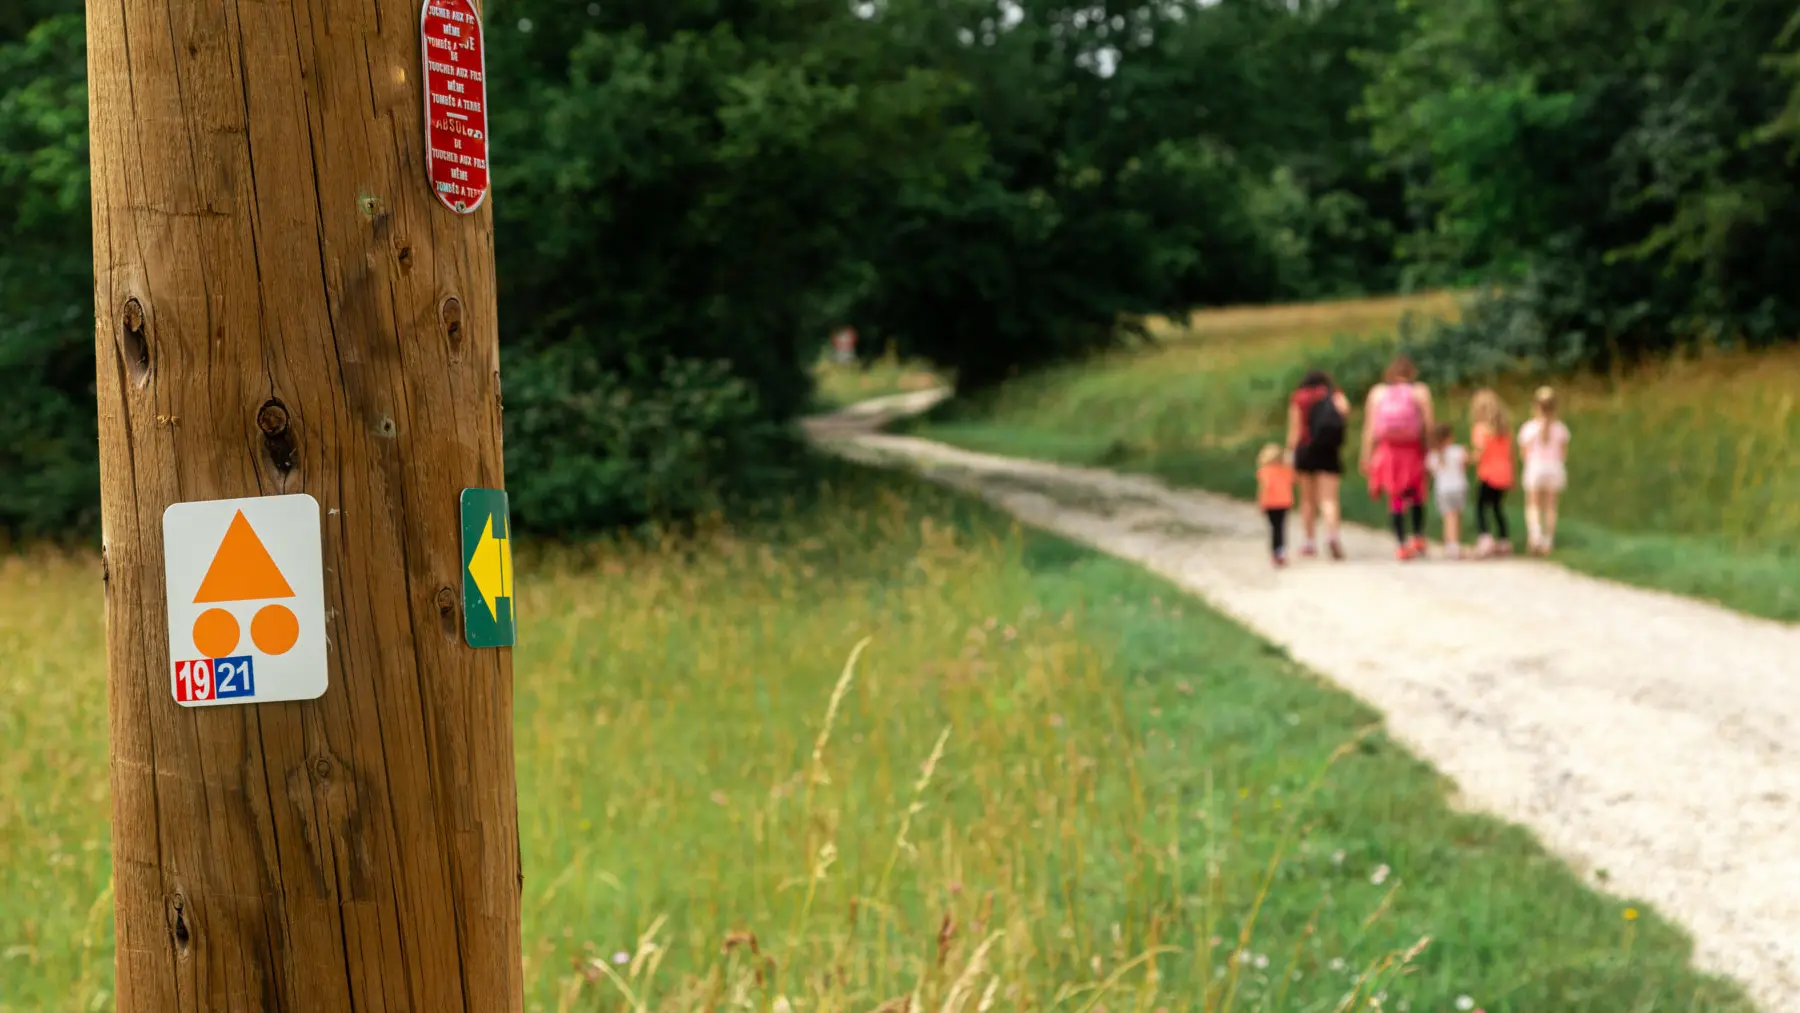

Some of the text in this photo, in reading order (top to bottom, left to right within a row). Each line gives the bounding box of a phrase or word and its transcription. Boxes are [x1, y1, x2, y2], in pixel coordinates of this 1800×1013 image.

[452, 11, 464, 22] AUX
[443, 23, 460, 37] MÊME
[428, 60, 482, 82] TOUCHER AUX FILS
[447, 79, 464, 94] MÊME
[432, 93, 481, 112] TOMBÉS A TERRE
[454, 138, 463, 149] DE
[432, 148, 486, 169] TOUCHER AUX FILS
[451, 167, 468, 181] MÊME
[436, 180, 459, 195] TOMBÉS
[461, 186, 466, 197] A
[179, 660, 251, 701] 19 21
